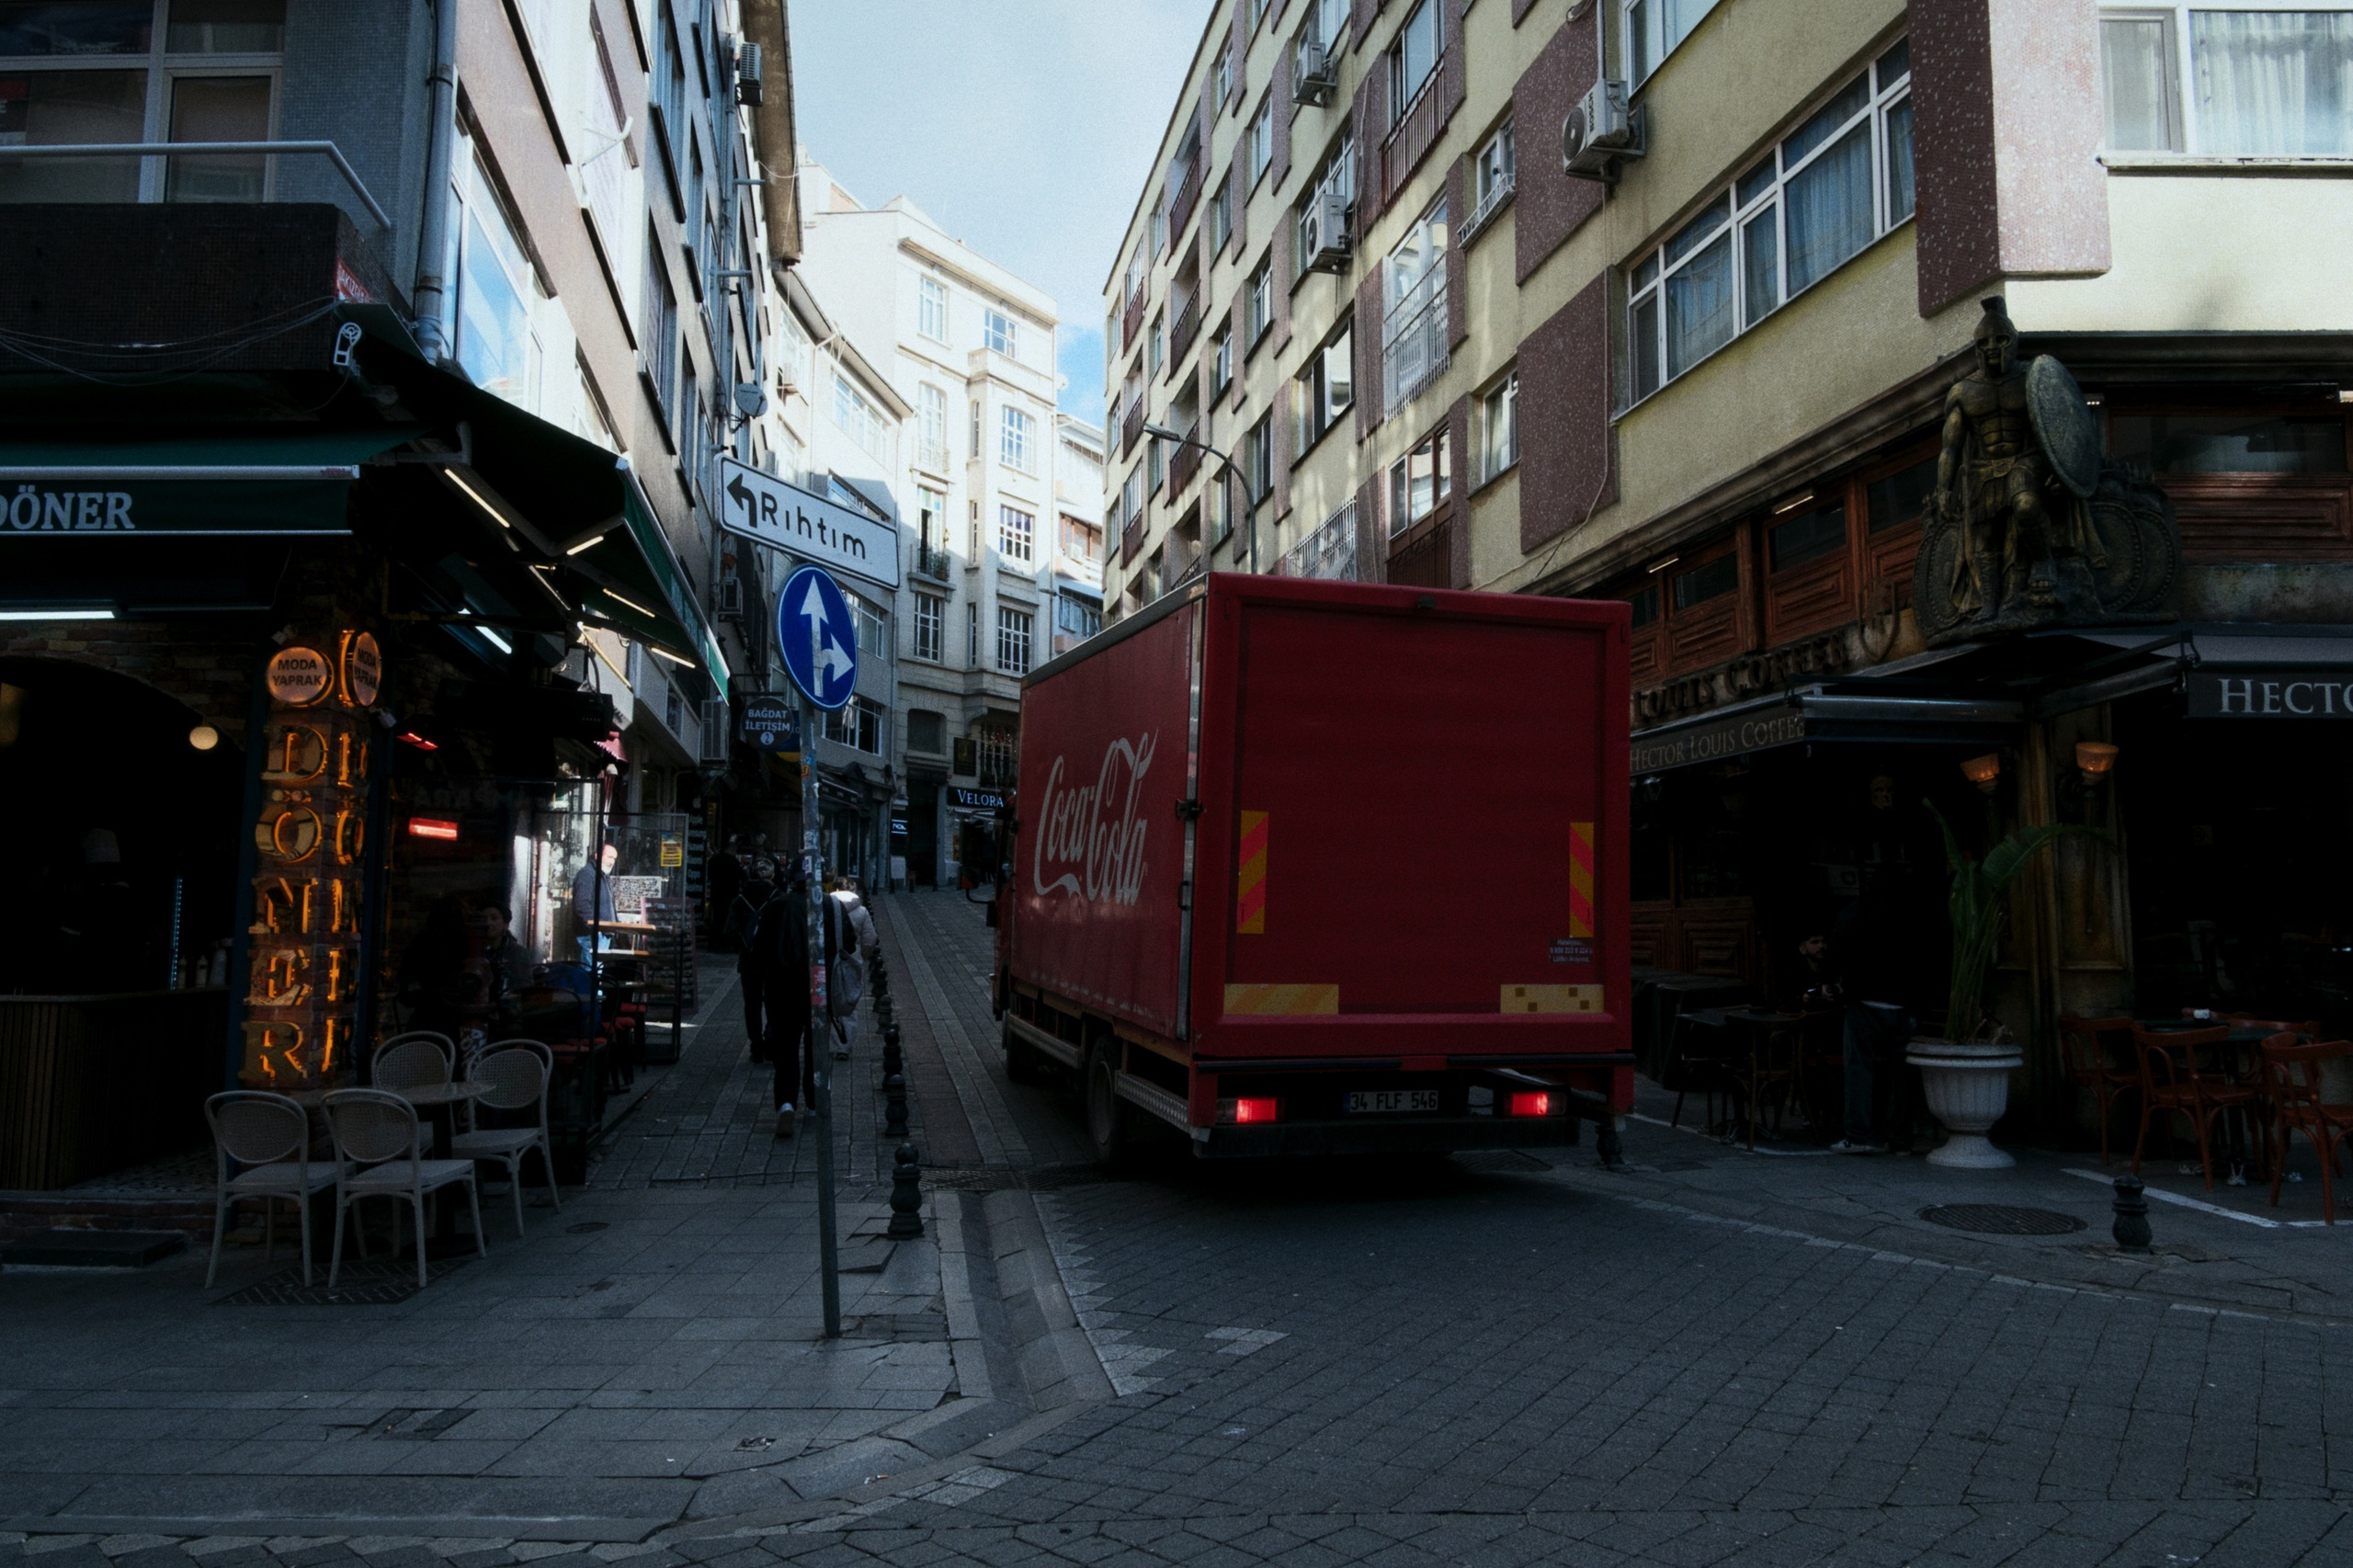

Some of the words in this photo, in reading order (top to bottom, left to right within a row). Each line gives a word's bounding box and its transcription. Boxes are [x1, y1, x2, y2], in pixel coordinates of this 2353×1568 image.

[761, 491, 866, 560] Rıhtım
[278, 659, 317, 670] MODA
[357, 648, 377, 667] MODA
[1723, 634, 1847, 697] COFFEE
[273, 675, 322, 686] YAPRAK
[355, 666, 378, 690] YAPRAK
[747, 707, 788, 719] BAĞDAT
[745, 719, 790, 733] İLETİŞİM
[764, 733, 770, 744] 2
[1631, 742, 1686, 771] HECTOR
[1689, 729, 1735, 759] LOUIS
[1741, 711, 1806, 748] COFFEE
[957, 789, 1005, 808] VELORA
[1034, 726, 1159, 906] Coca-Cola
[237, 724, 329, 1082] DÖNER
[1351, 1094, 1368, 1110] 34
[1376, 1093, 1403, 1110] FLF
[1411, 1092, 1437, 1109] 546
